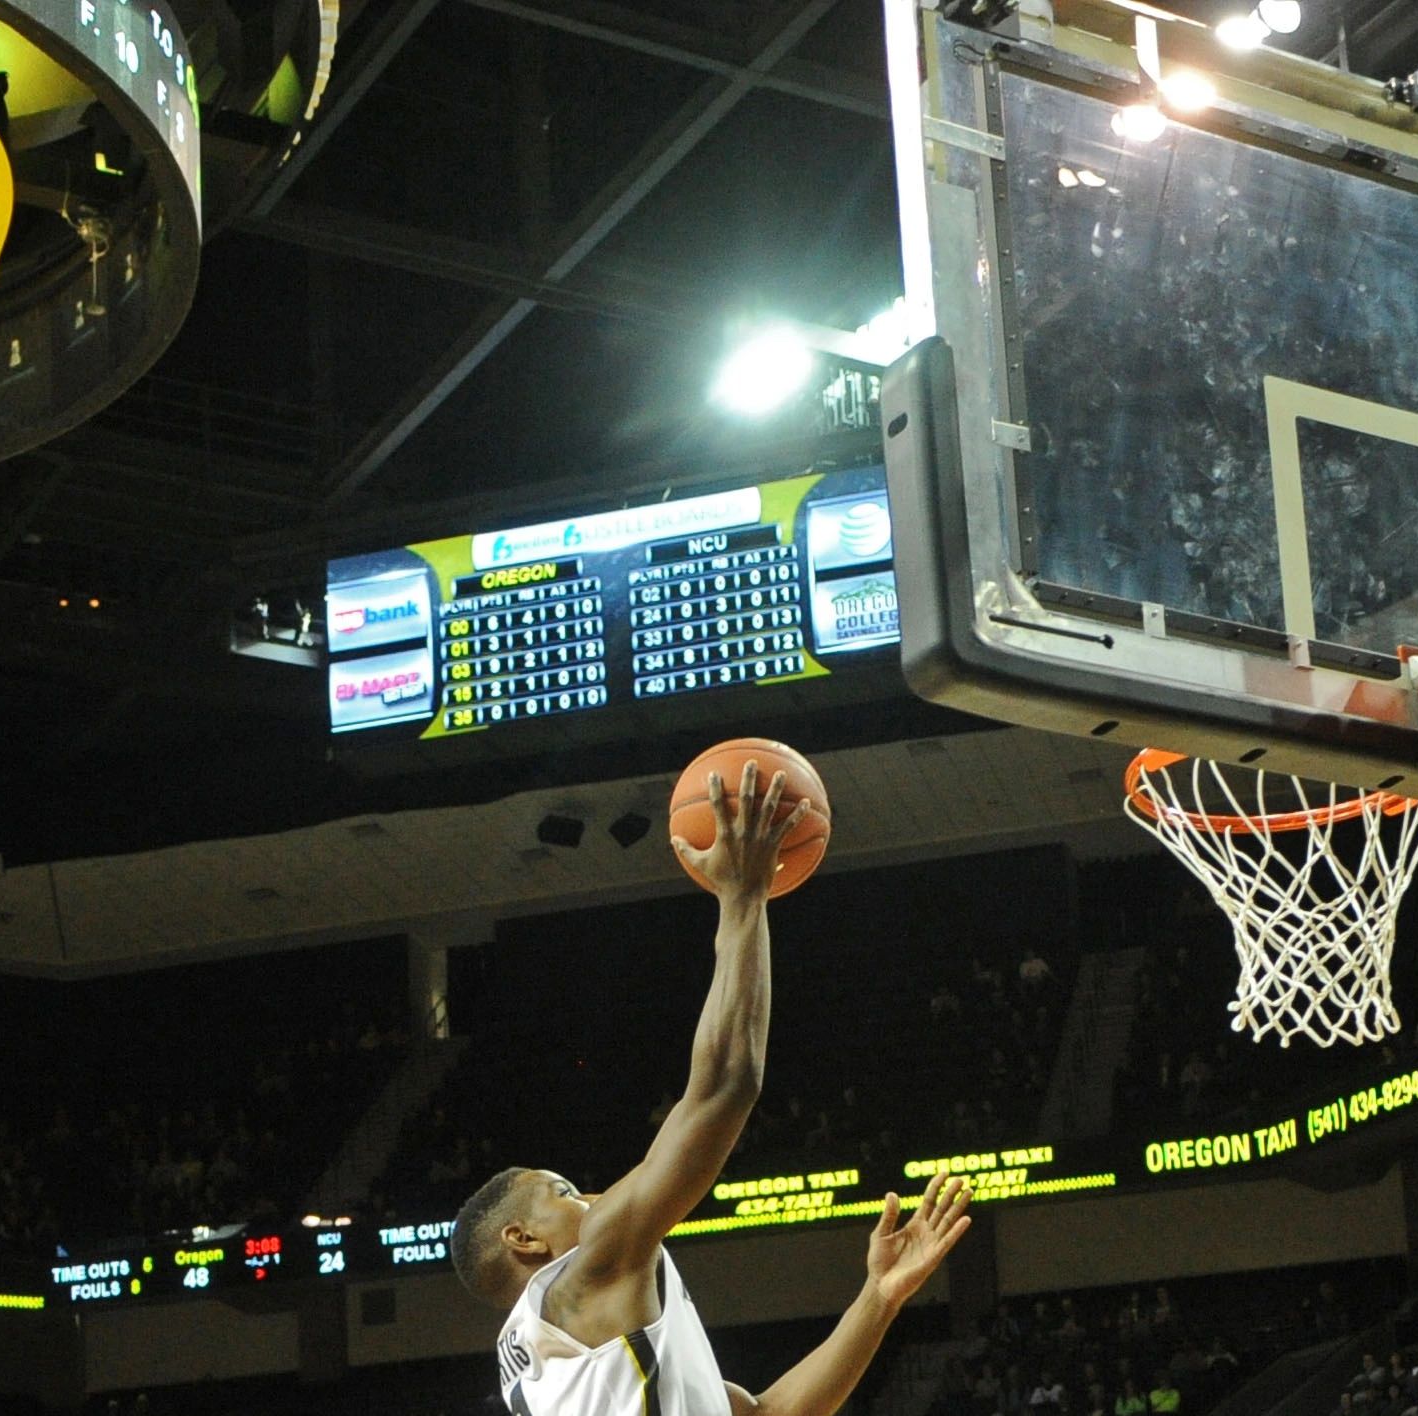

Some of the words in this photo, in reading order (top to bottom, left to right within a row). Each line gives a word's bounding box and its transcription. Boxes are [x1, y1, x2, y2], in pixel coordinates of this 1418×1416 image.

[688, 534, 728, 555] NCU
[482, 563, 556, 589] OREGON
[641, 587, 661, 603] 02
[680, 581, 691, 596] 0
[715, 575, 726, 590] 0
[750, 569, 761, 585] 0
[779, 564, 789, 580] 0
[365, 600, 419, 624] bank
[643, 609, 662, 625] 24
[681, 603, 692, 618] 0
[751, 591, 762, 606] 0
[780, 586, 789, 602] 1
[835, 592, 897, 616] OREGO
[450, 619, 469, 636] 00
[522, 610, 534, 625] 4
[555, 602, 566, 618] 0
[582, 598, 593, 614] 0
[682, 625, 693, 640] 0
[717, 619, 728, 635] 0
[752, 613, 763, 629] 0
[836, 609, 899, 631] COLLEG
[451, 641, 469, 657] 01
[524, 630, 534, 645] 1
[557, 625, 566, 639] 1
[584, 620, 593, 635] 1
[719, 643, 729, 659] 1
[754, 637, 765, 653] 0
[558, 647, 567, 662] 1
[526, 676, 535, 691] 1
[558, 670, 570, 686] 0
[586, 665, 597, 681] 0
[646, 678, 665, 693] 40
[755, 661, 766, 677] 0
[784, 656, 794, 672] 1
[491, 704, 503, 720] 0
[526, 699, 537, 714] 0
[559, 694, 571, 709] 0
[587, 689, 598, 705] 0
[1145, 1131, 1249, 1174] OREGON
[1255, 1119, 1297, 1160] TAXI
[1307, 1095, 1348, 1145] (541)
[904, 1153, 997, 1178] OREGON
[1000, 1146, 1053, 1166] TAXI
[713, 1175, 805, 1200] OREGON
[808, 1169, 859, 1187] TAXI
[734, 1190, 834, 1215] 434-TAXI
[316, 1232, 342, 1246] NCU
[378, 1226, 415, 1246] TIME
[174, 1248, 224, 1266] Oregon
[319, 1250, 345, 1274] 24
[393, 1243, 446, 1264] FOULS
[52, 1266, 87, 1284] TIME
[88, 1259, 130, 1281] OUTS
[183, 1266, 210, 1289] 48
[70, 1280, 121, 1301] FOULS
